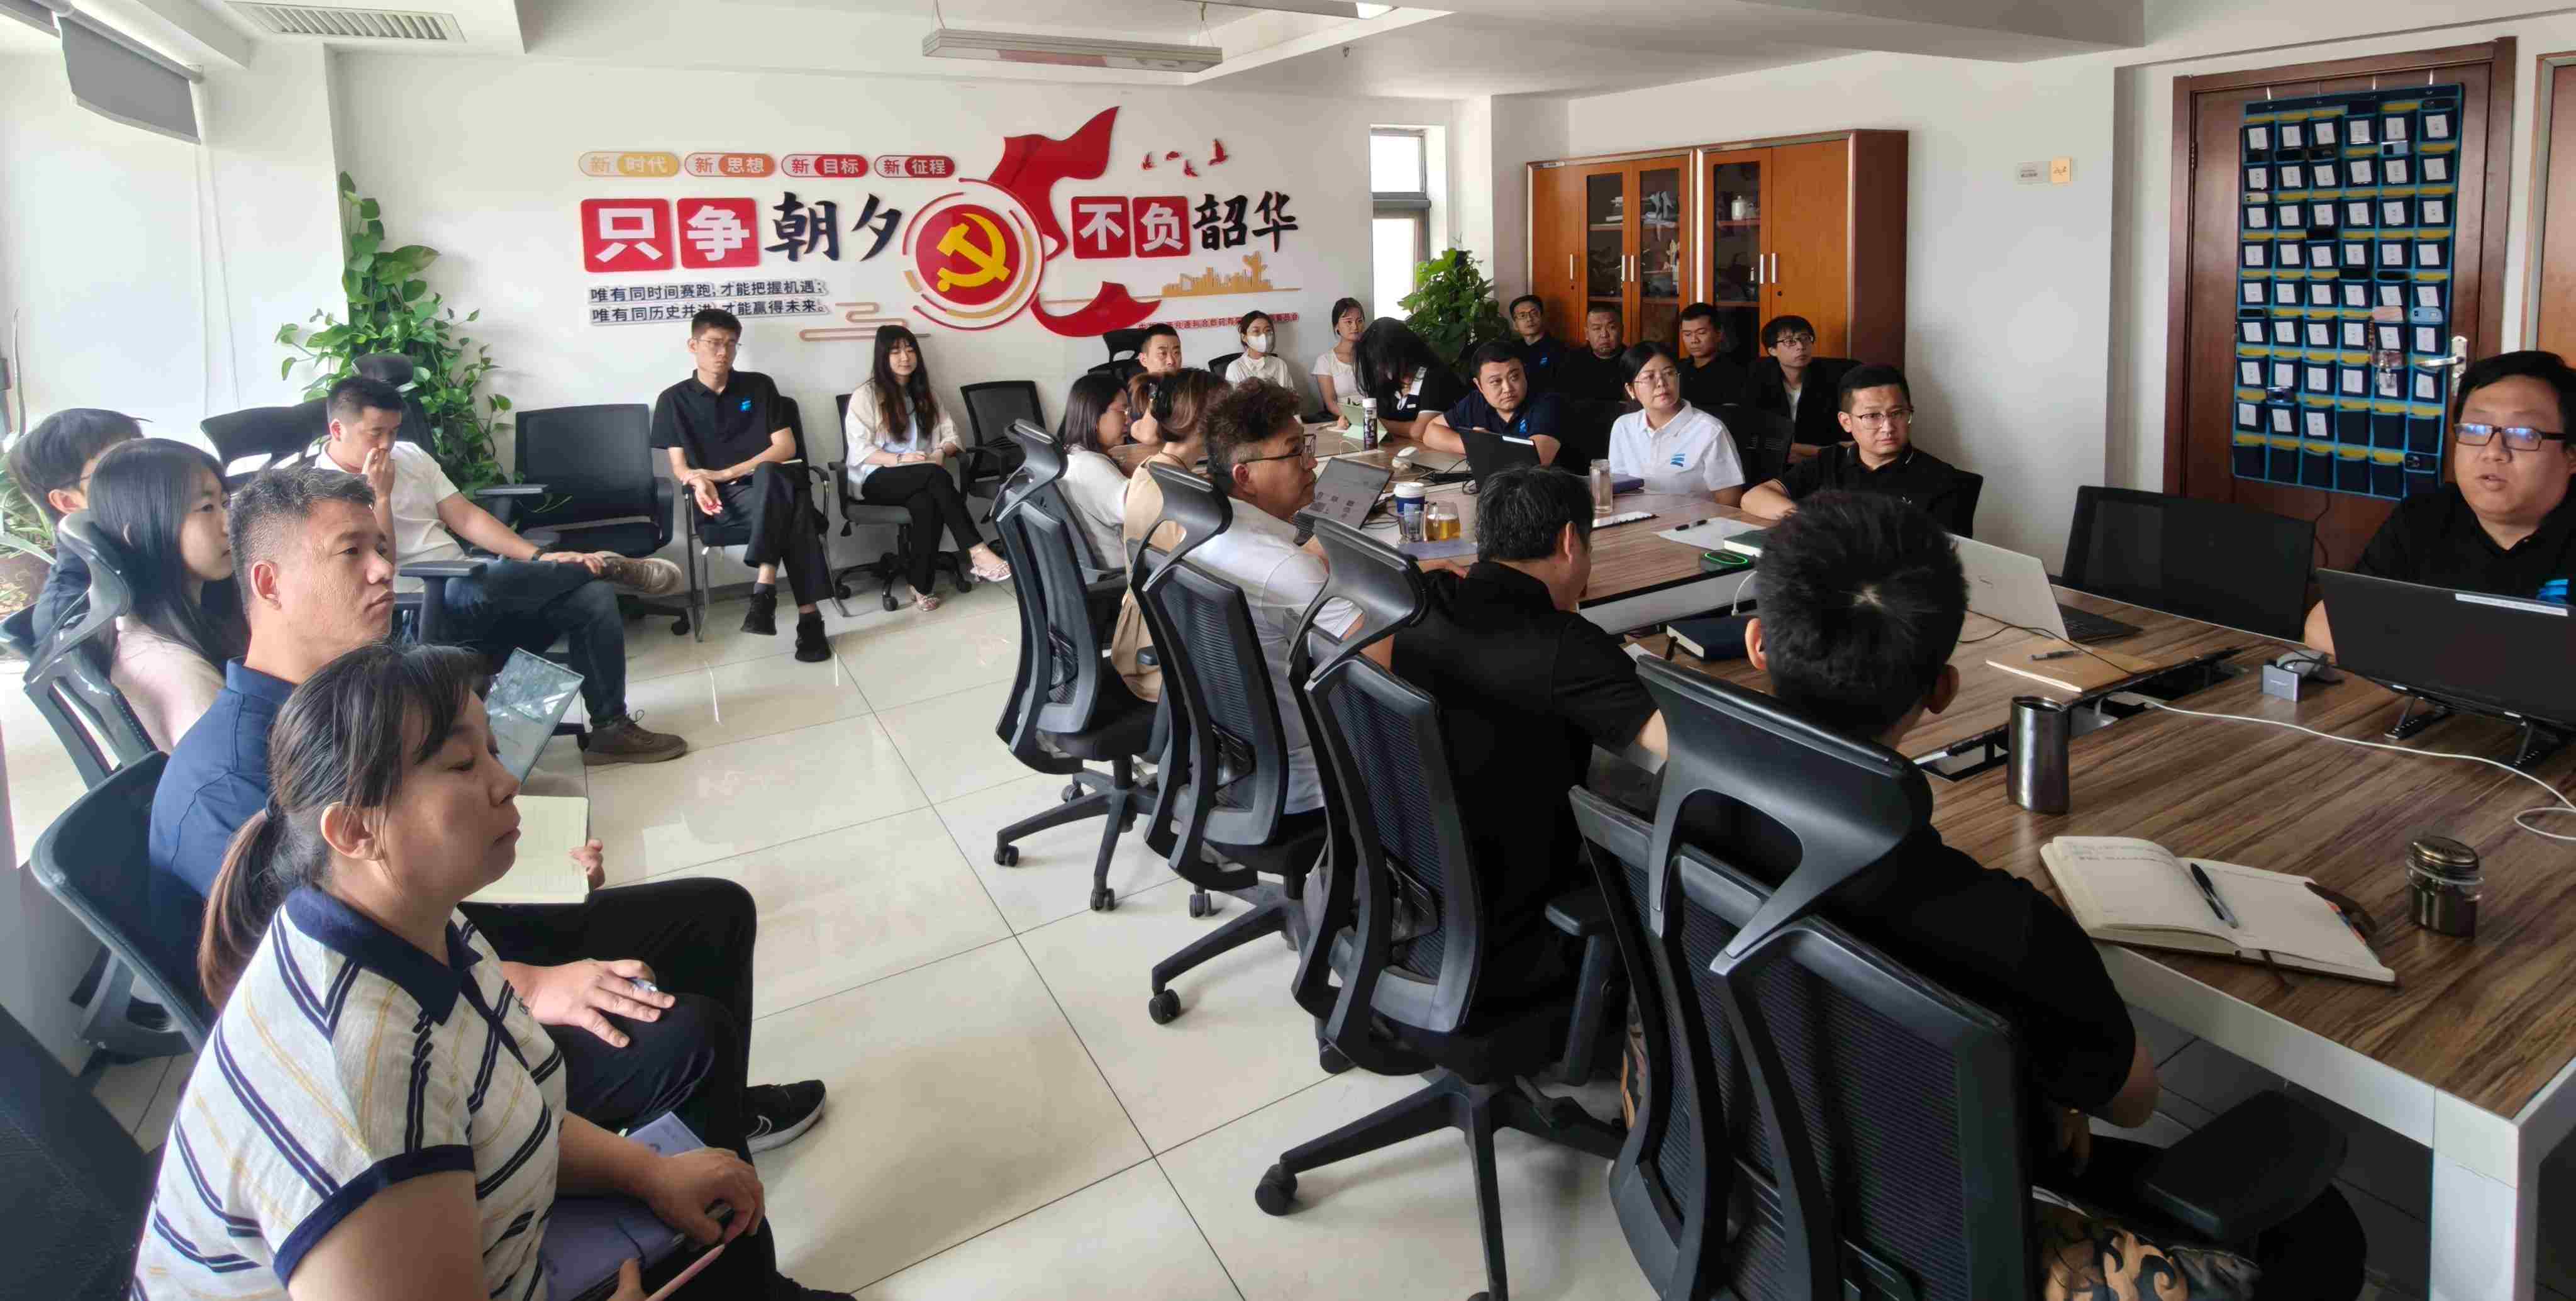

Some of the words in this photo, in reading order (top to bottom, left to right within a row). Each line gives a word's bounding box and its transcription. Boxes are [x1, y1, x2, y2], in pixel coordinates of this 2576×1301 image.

[589, 157, 668, 172] 新时代
[696, 157, 765, 173] 新思想
[791, 158, 858, 174] 新目标
[884, 159, 946, 175] 新征程
[595, 191, 902, 262] 只争朝夕
[1077, 191, 1299, 253] 不负韶华
[592, 299, 824, 321] 唯有同历史并才能赢得未来。
